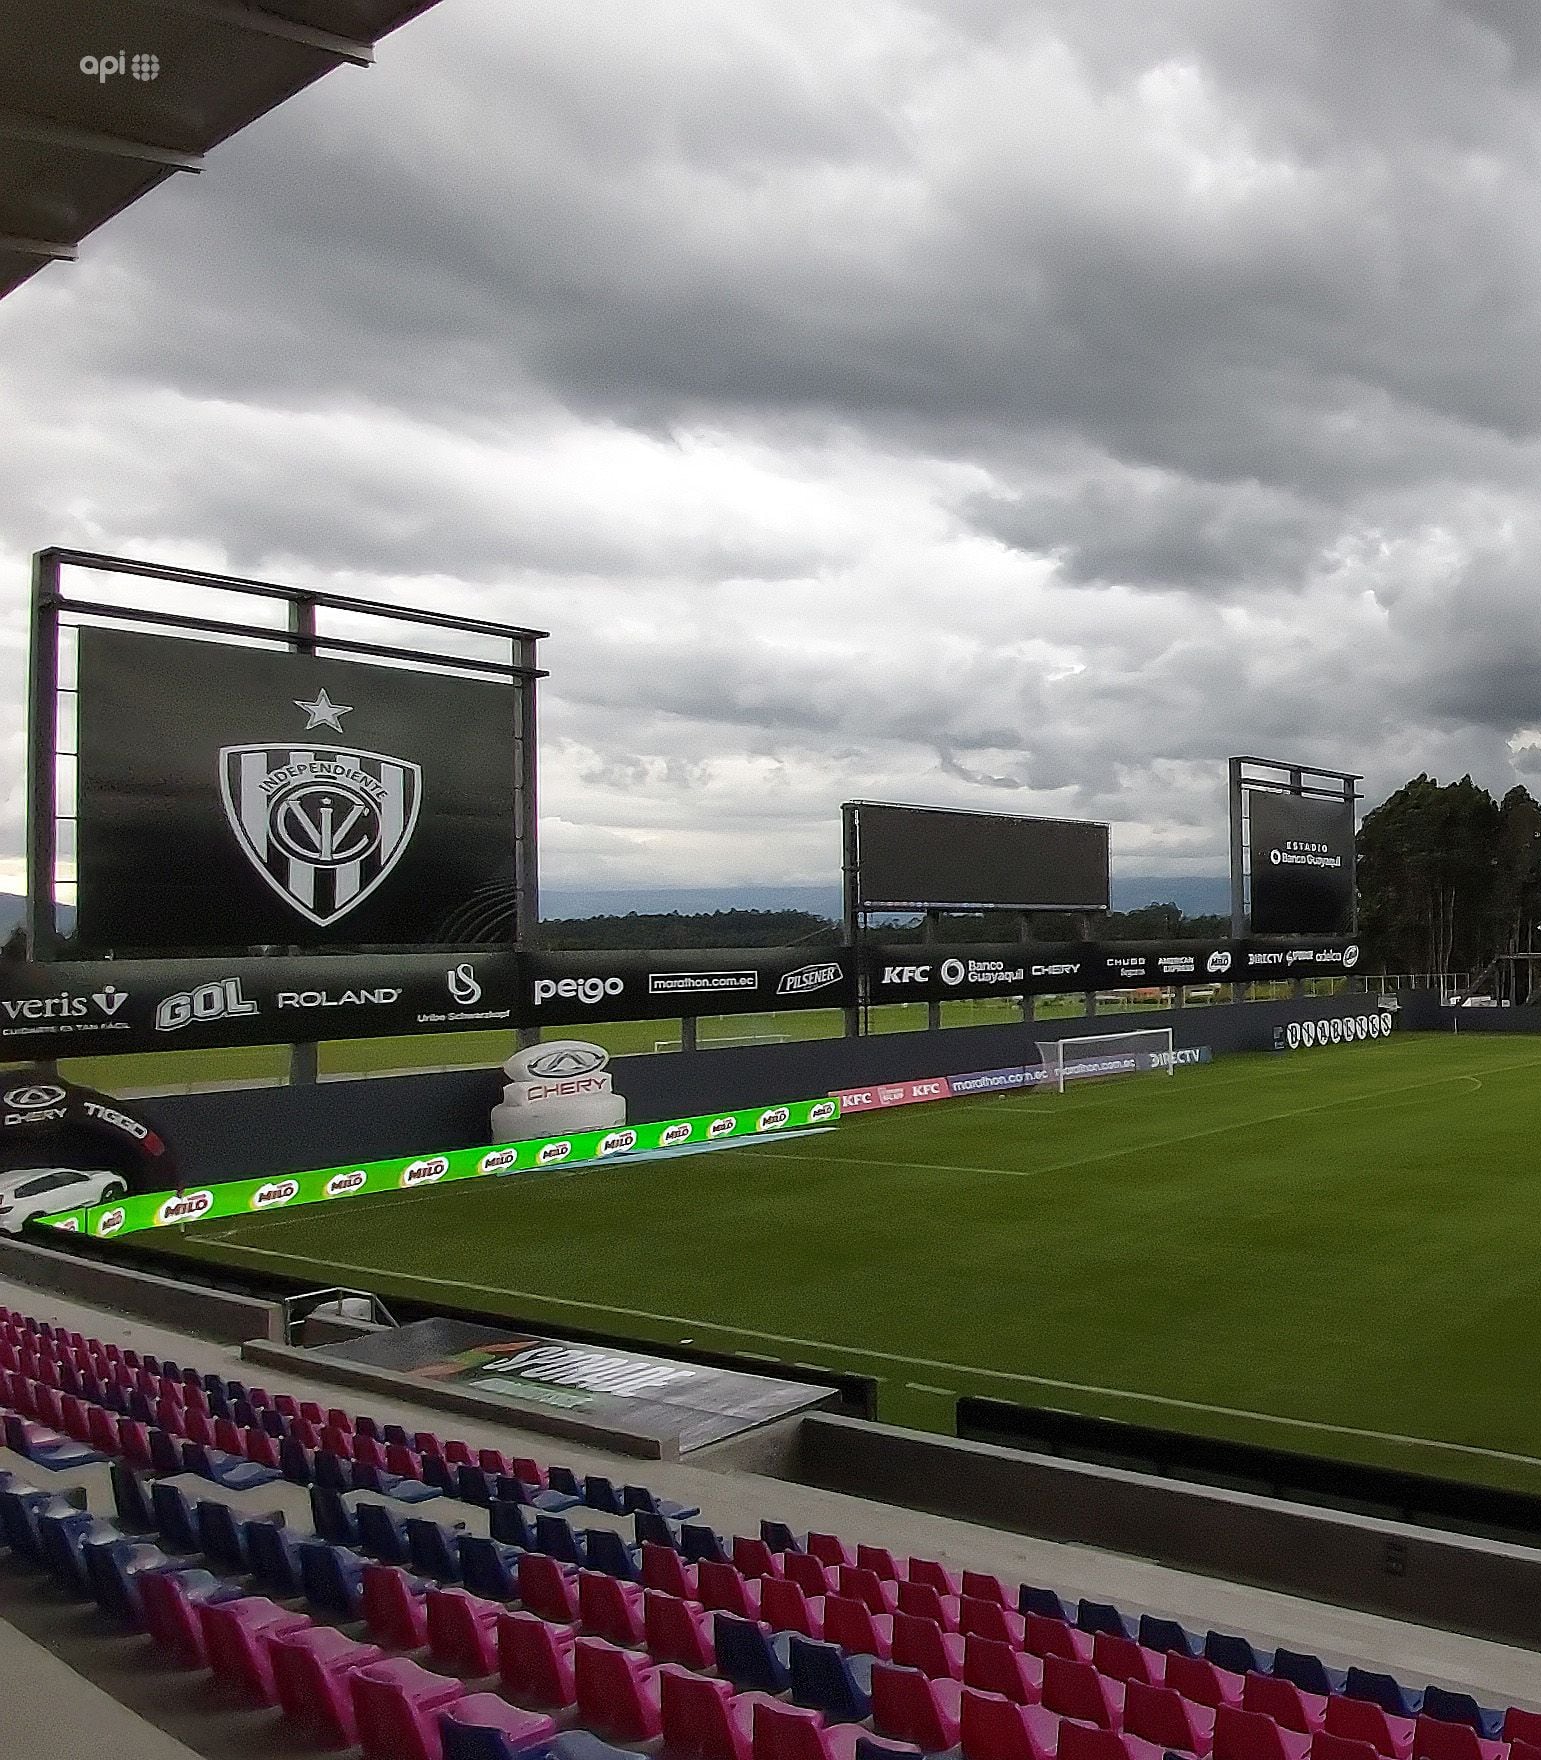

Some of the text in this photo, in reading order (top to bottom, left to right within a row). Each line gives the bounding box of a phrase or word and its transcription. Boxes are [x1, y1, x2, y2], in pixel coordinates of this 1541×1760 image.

[259, 762, 388, 800] INDEPENDIENTE
[1286, 841, 1328, 853] ESTADIO
[1282, 853, 1306, 864] Banco
[968, 960, 1004, 971] Banco
[1032, 963, 1081, 976] CHERY
[653, 975, 754, 990] marathon.com.ec
[785, 967, 836, 992] PILSENER
[881, 966, 931, 984] KFC
[968, 969, 1024, 984] Guayaquil
[278, 987, 399, 1009] ROLAND
[534, 977, 624, 1005] peigo
[2, 991, 89, 1019] veris
[156, 977, 261, 1031] GOL
[417, 1012, 446, 1023] Uribe
[952, 1068, 1048, 1092] marathon.com.ec
[527, 1076, 608, 1101] CHERY
[912, 1083, 940, 1097] KFC
[842, 1092, 872, 1107] KFC
[666, 1127, 690, 1140] MILO
[604, 1136, 634, 1150] MILO
[543, 1146, 568, 1160] MILO
[485, 1154, 514, 1169] MILO
[408, 1164, 445, 1181] MILO
[331, 1176, 363, 1191] MILO
[258, 1186, 295, 1203] MILO
[165, 1198, 208, 1218] MILO
